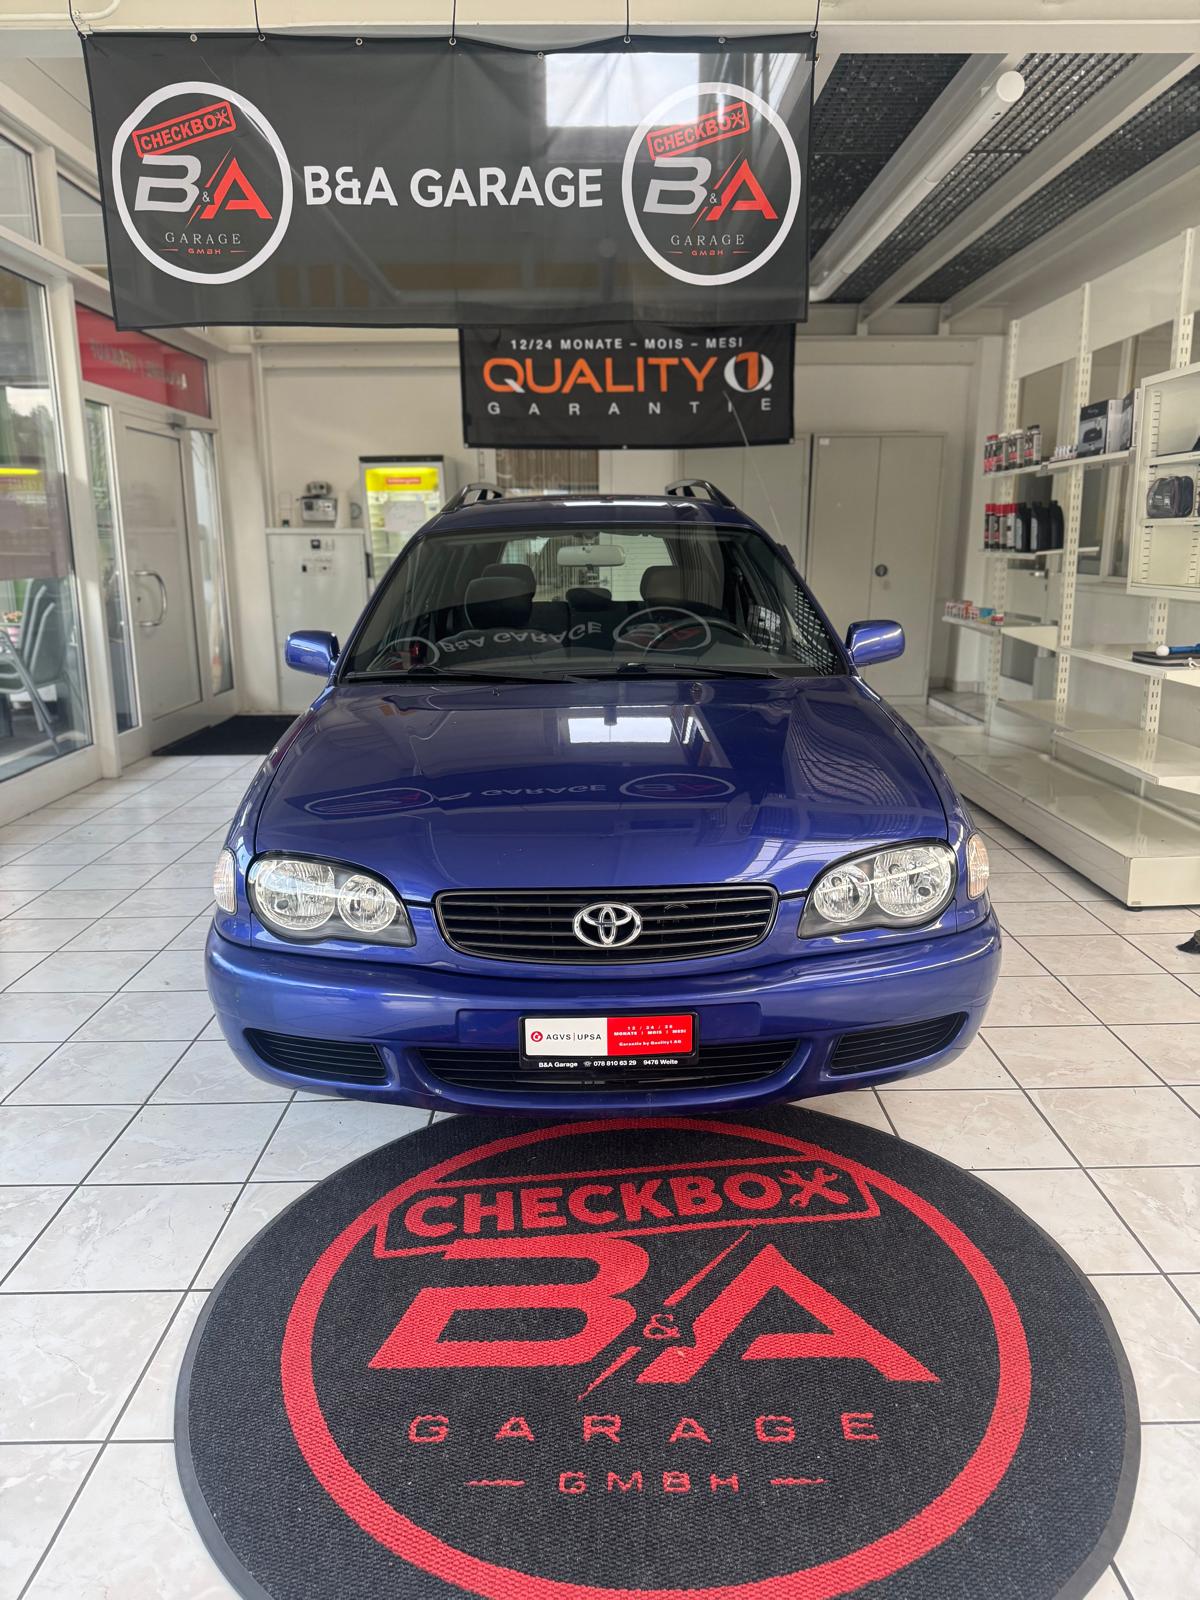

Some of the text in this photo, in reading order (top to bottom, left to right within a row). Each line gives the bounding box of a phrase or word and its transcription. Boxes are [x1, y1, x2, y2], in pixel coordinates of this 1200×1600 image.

[140, 109, 230, 151] CHECKBOX
[653, 110, 745, 154] CHECKBOX
[134, 154, 273, 220] B&A
[303, 165, 603, 208] B&A GARAGE
[642, 156, 779, 222] B&A
[165, 231, 242, 245] GARAGE
[187, 247, 222, 256] GMBH
[670, 233, 745, 247] GARAGE
[691, 248, 725, 256] GMBH
[510, 336, 743, 350] 12/24 MONATE MOIS MESI
[483, 356, 718, 394] QUALITY
[487, 397, 772, 416] GARANTIE
[546, 1033, 602, 1041] AGVS UPSA
[404, 1167, 849, 1238] CHECKBOX
[367, 1236, 940, 1386] B&A
[407, 1412, 880, 1444] GARAGE
[558, 1471, 741, 1494] GMBH
